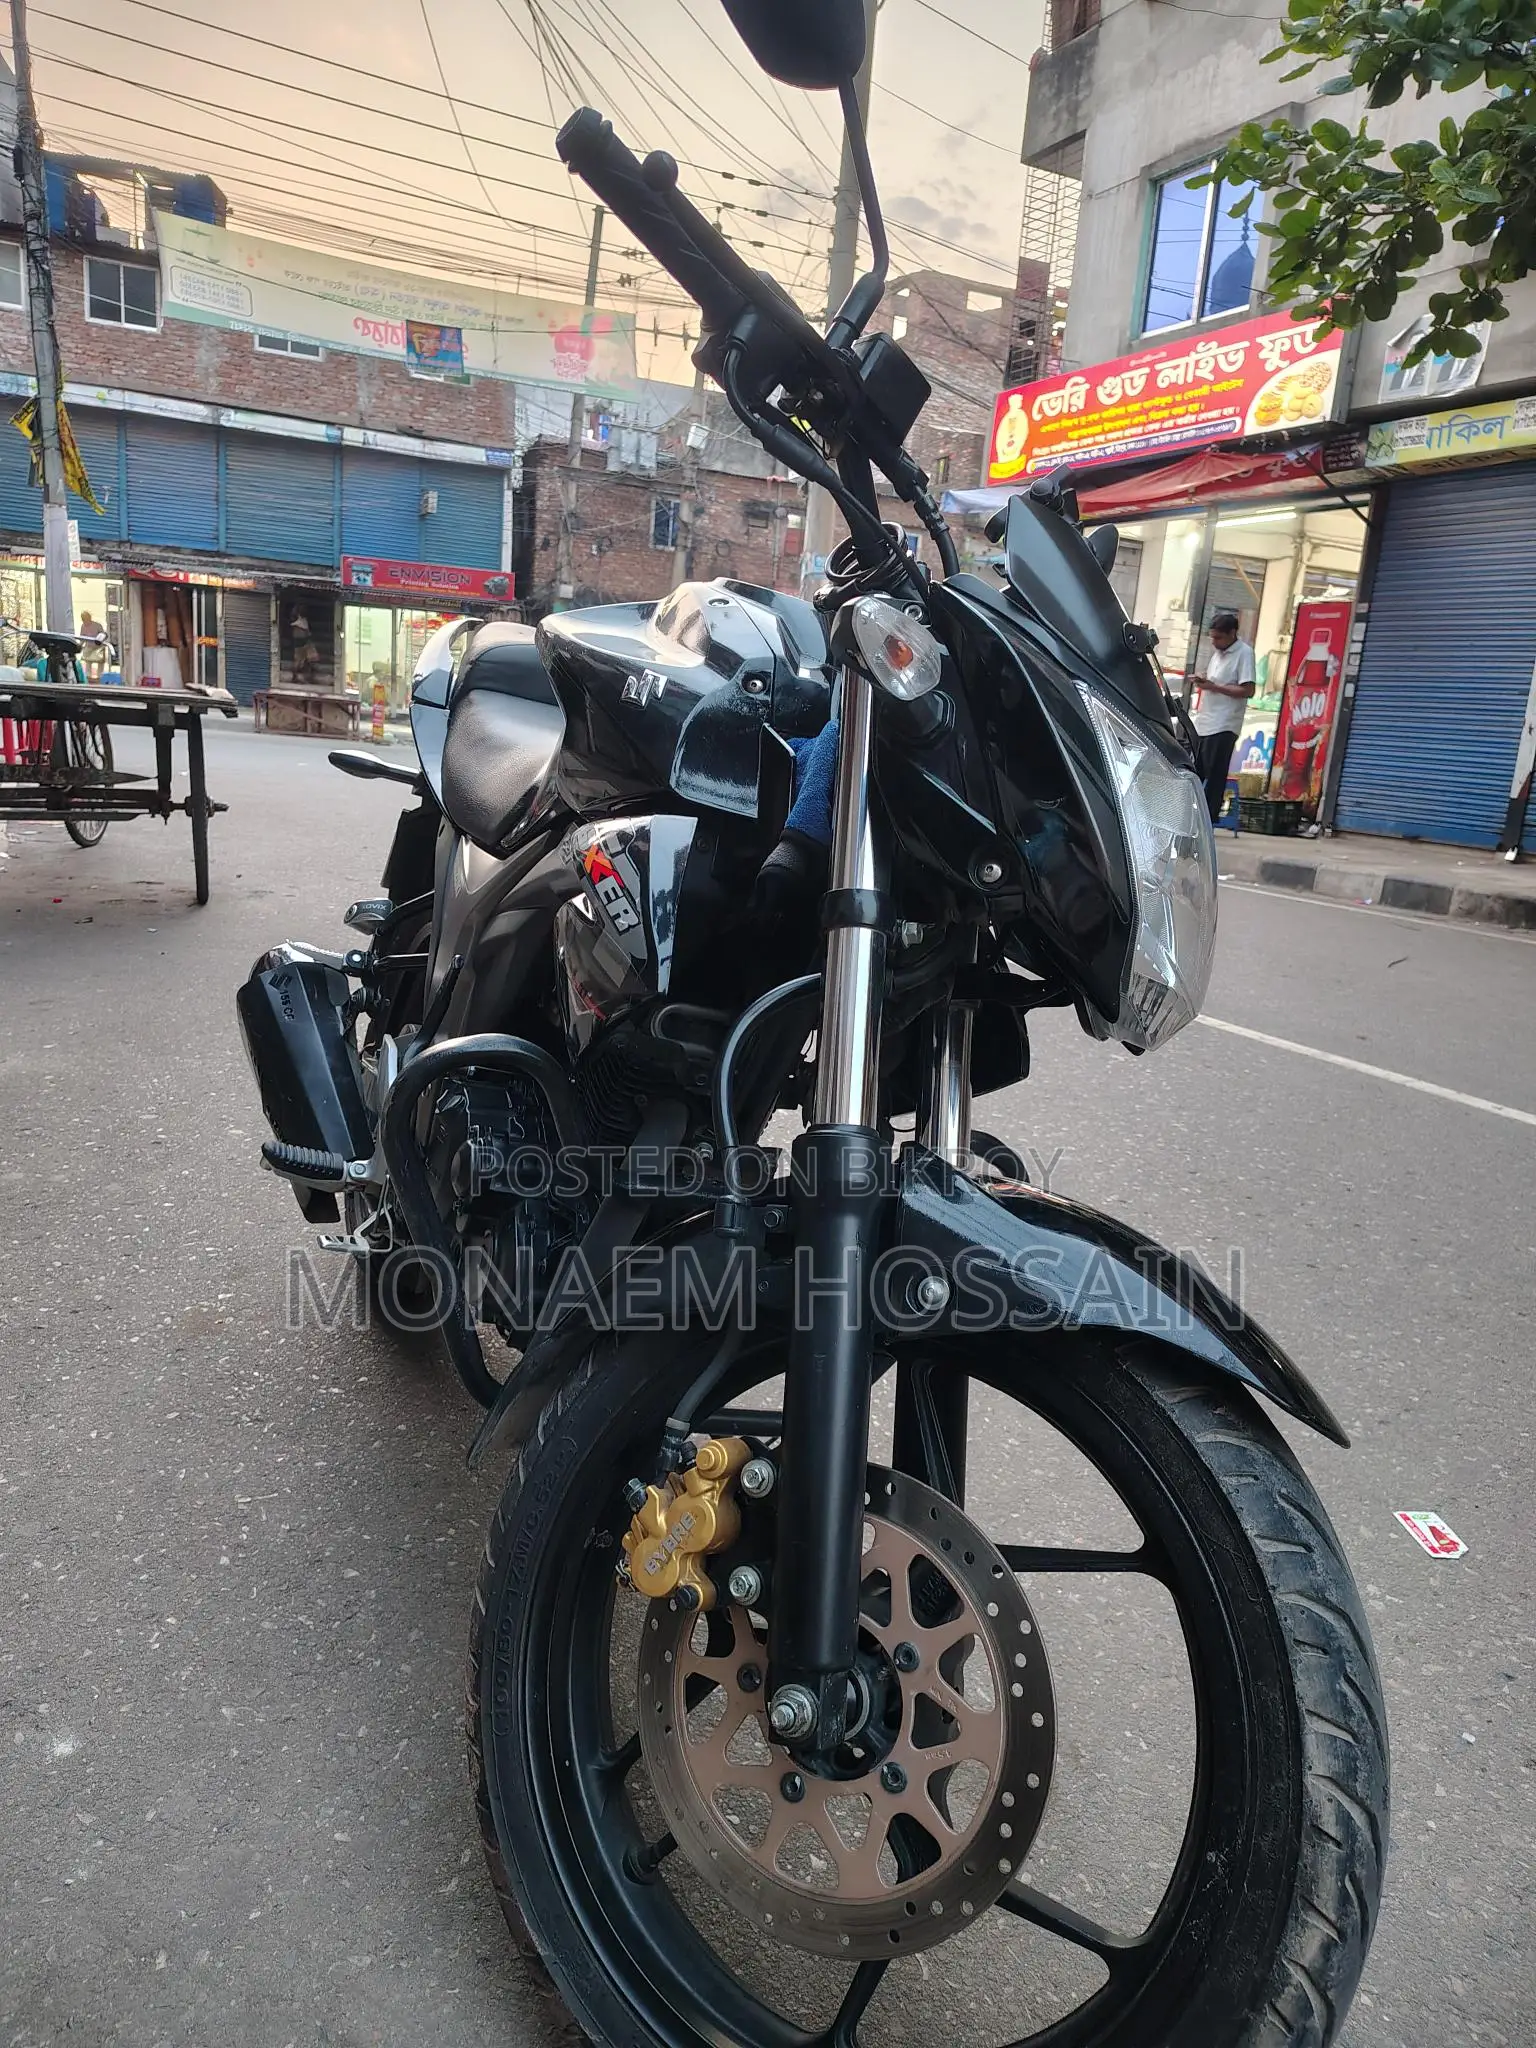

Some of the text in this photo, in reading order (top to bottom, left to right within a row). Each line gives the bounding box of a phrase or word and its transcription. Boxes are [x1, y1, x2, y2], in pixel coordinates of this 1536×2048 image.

[1032, 376, 1090, 421] ভেরি
[1097, 367, 1150, 405] গুড
[1155, 341, 1250, 388] লাইভ
[1256, 320, 1327, 372] ফুড
[388, 567, 471, 585] ENVISION
[644, 1511, 697, 1577] BYBRE
